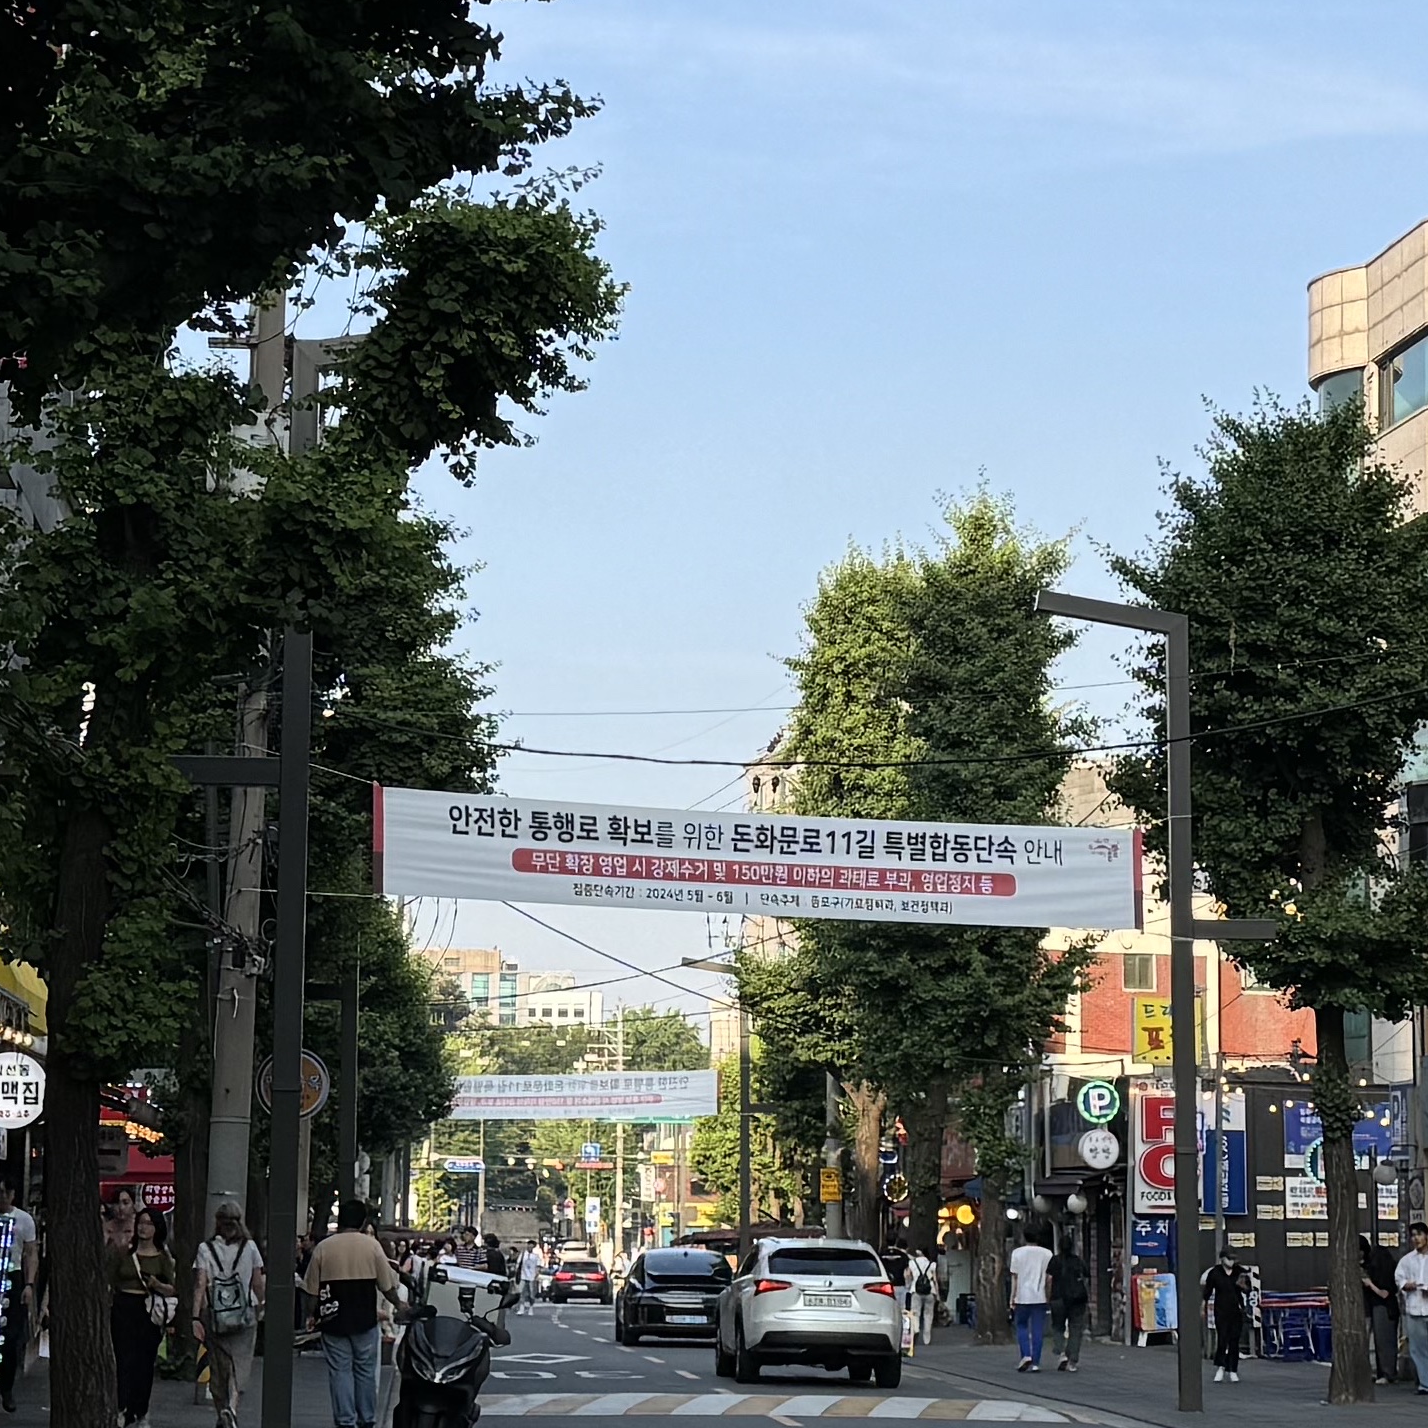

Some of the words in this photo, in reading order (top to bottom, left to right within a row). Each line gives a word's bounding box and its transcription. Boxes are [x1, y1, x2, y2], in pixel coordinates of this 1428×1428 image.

[448, 805, 521, 839] 안전한
[529, 810, 600, 843] 통행로
[607, 814, 675, 849] 확보를
[683, 822, 724, 851] 위한
[731, 823, 875, 860] 돈화문로11길
[883, 830, 1017, 865] 특별합동단속
[1024, 838, 1063, 866] 안내
[531, 852, 561, 871] 무단
[565, 853, 594, 873] 확장
[599, 855, 628, 875] 영업
[632, 857, 646, 877] 시
[651, 858, 709, 880] 강제수거
[732, 863, 787, 885] 150만원
[793, 868, 834, 888] 이하의
[921, 873, 975, 894] 영업정지
[979, 875, 994, 894] 등
[646, 887, 683, 901] 2024년
